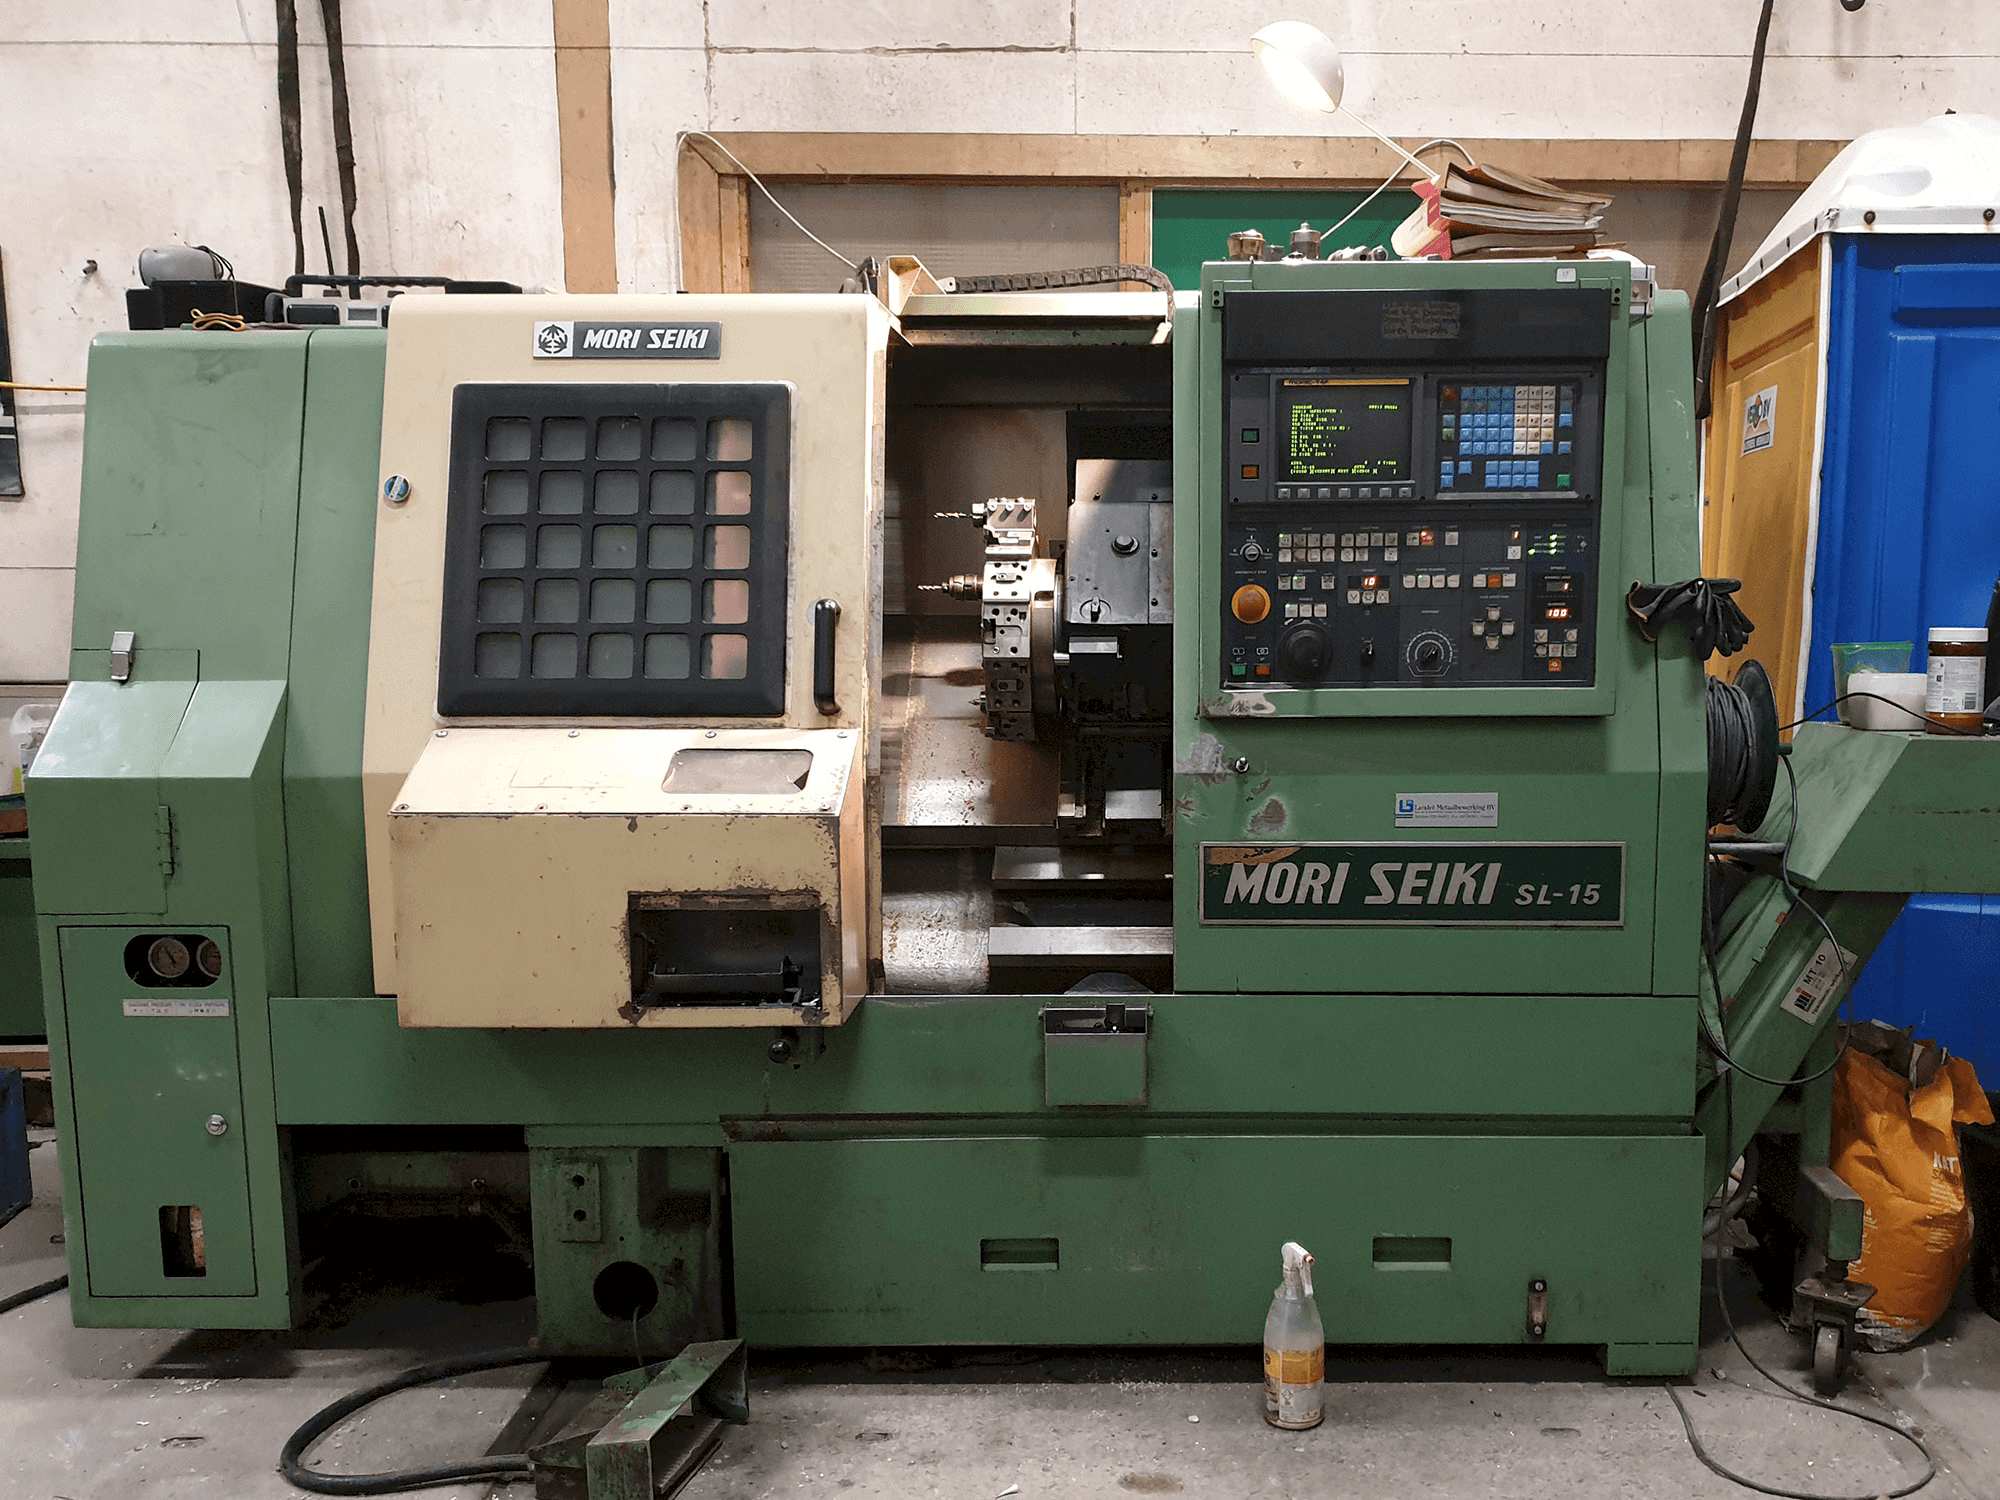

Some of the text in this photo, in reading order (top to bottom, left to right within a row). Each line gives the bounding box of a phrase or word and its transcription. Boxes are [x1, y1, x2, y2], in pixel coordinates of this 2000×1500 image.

[583, 329, 709, 349] MORI SEIKI
[1547, 609, 1568, 618] 100
[1223, 862, 1502, 905] MORI SEIKI
[1514, 884, 1602, 906] SL-15
[1804, 967, 1818, 984] MT
[1815, 954, 1826, 966] 10
